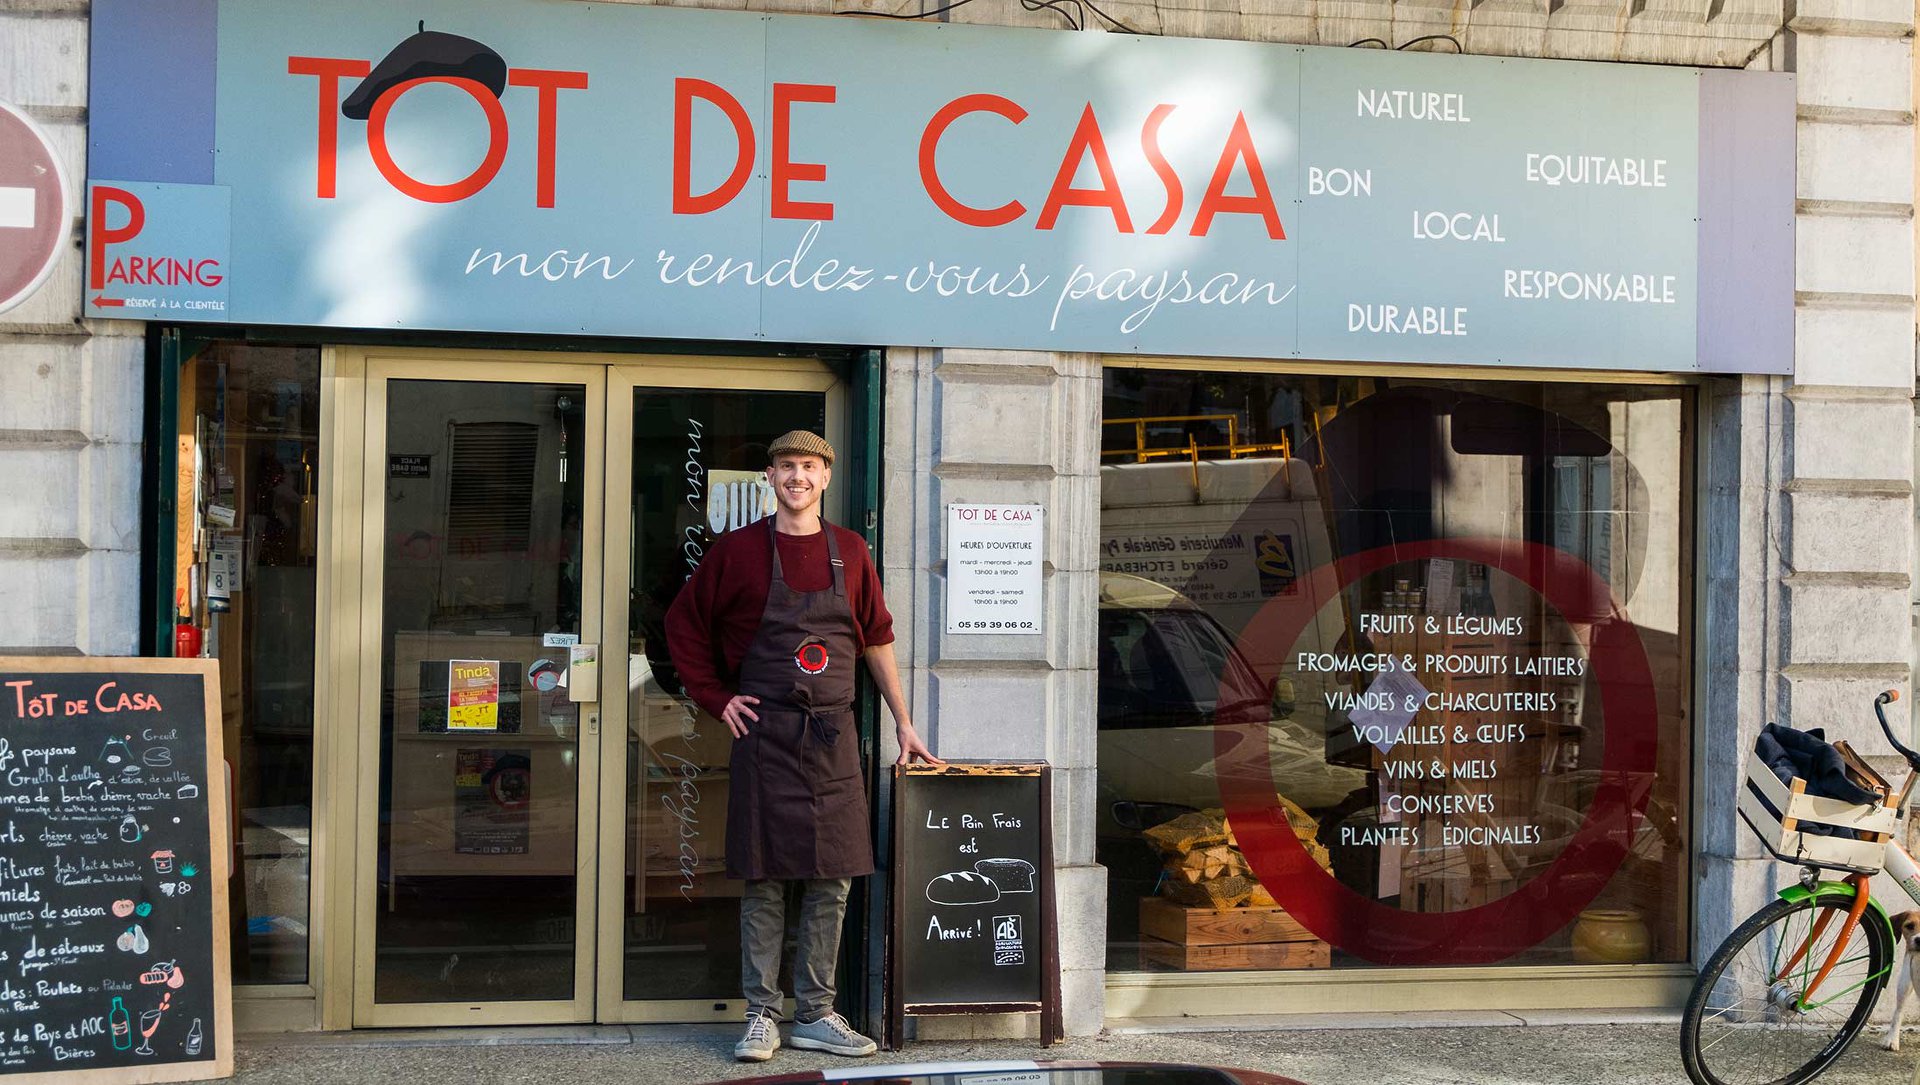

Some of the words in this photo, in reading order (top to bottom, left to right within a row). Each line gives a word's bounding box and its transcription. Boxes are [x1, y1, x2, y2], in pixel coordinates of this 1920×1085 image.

[1357, 89, 1471, 123] NATUREL
[288, 56, 588, 208] TOT
[673, 77, 836, 220] DE
[918, 93, 1287, 240] CASA
[1526, 153, 1667, 187] EQUITABLE
[1309, 166, 1371, 197] BON
[1413, 210, 1506, 242] LOCAL
[91, 186, 223, 289] PARKING
[465, 247, 634, 282] mon
[656, 221, 1050, 297] rendez-vous
[1050, 264, 1296, 333] paysan
[1504, 269, 1676, 303] RESPONSABLE
[171, 301, 181, 309] LA
[1348, 303, 1468, 336] DURABLE
[684, 418, 703, 511] mon
[957, 508, 979, 520] TOT
[984, 509, 997, 521] DE
[1003, 509, 1032, 521] CASA
[960, 542, 984, 550] HEURES
[987, 542, 1032, 550] D'OUVERTURE
[1360, 614, 1415, 633] FRUITS
[1425, 615, 1440, 634] &
[1447, 613, 1523, 636] LÉGUMES
[455, 666, 491, 680] Tinda
[1298, 652, 1395, 673] FROMAGES
[1402, 653, 1417, 673] &
[1425, 654, 1507, 674] PRODUITS
[1515, 656, 1584, 676] LAITIERS
[1324, 691, 1395, 711] VIANDES
[1404, 694, 1419, 713] &
[1424, 692, 1557, 711] CHARCUTERIES
[1352, 725, 1446, 745] VOLAILLES
[1453, 725, 1468, 744] &
[1477, 723, 1525, 743] ŒUFS
[22, 746, 77, 767] paysans
[1383, 760, 1424, 779] VINS
[1430, 760, 1446, 779] &
[1453, 759, 1497, 779] MIELS
[34, 787, 51, 803] de
[137, 787, 171, 801] vache
[1387, 794, 1495, 815] CONSERVES
[662, 753, 702, 902] paysan
[962, 814, 984, 829] Pain
[992, 813, 1022, 829] Frais
[80, 827, 109, 841] vache
[959, 837, 979, 853] est
[1341, 827, 1418, 846] PLANTES
[40, 902, 57, 919] de
[61, 905, 106, 918] saison
[24, 934, 46, 959] de
[51, 937, 105, 955] côteaux
[36, 980, 83, 997] Poulets
[14, 1028, 29, 1043] de
[34, 1023, 62, 1048] Pays
[64, 1023, 78, 1040] et
[81, 1016, 106, 1036] AOC
[54, 1046, 96, 1060] Bières
